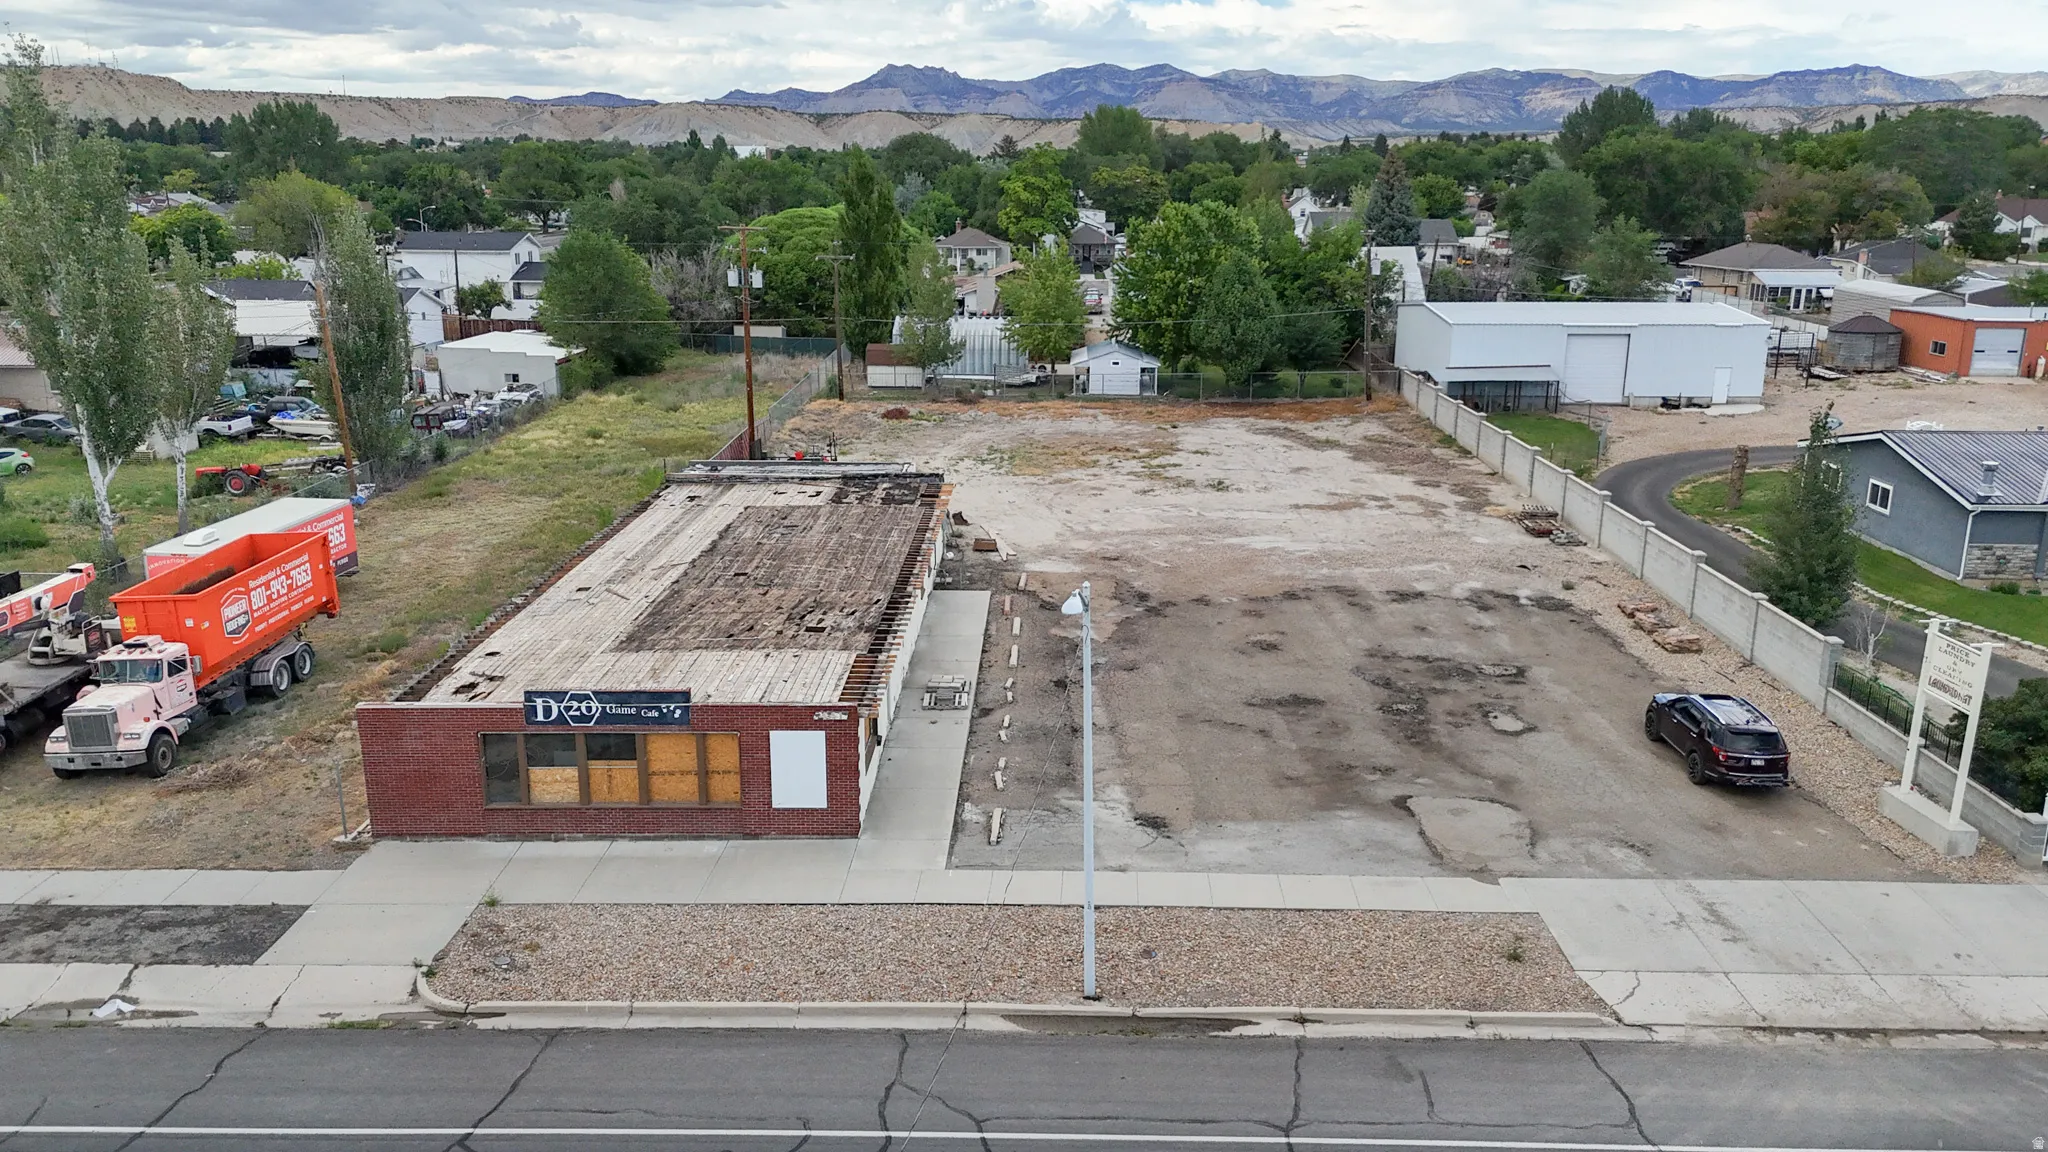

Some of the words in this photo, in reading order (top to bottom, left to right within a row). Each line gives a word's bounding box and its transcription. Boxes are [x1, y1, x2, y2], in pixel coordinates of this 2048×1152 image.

[312, 512, 344, 531] Commercial
[148, 558, 185, 570] INNOVATION
[248, 569, 276, 588] Residential
[281, 553, 309, 572] Commercial
[250, 562, 312, 610] 801-943-7663
[223, 598, 247, 620] PIONEER
[253, 606, 270, 618] MASTER
[288, 582, 313, 598] CONTRACTOR
[1938, 646, 1976, 668] LAUNDRY
[1946, 643, 1970, 658] PRICE
[606, 704, 637, 715] Game
[641, 709, 659, 717] Cafe
